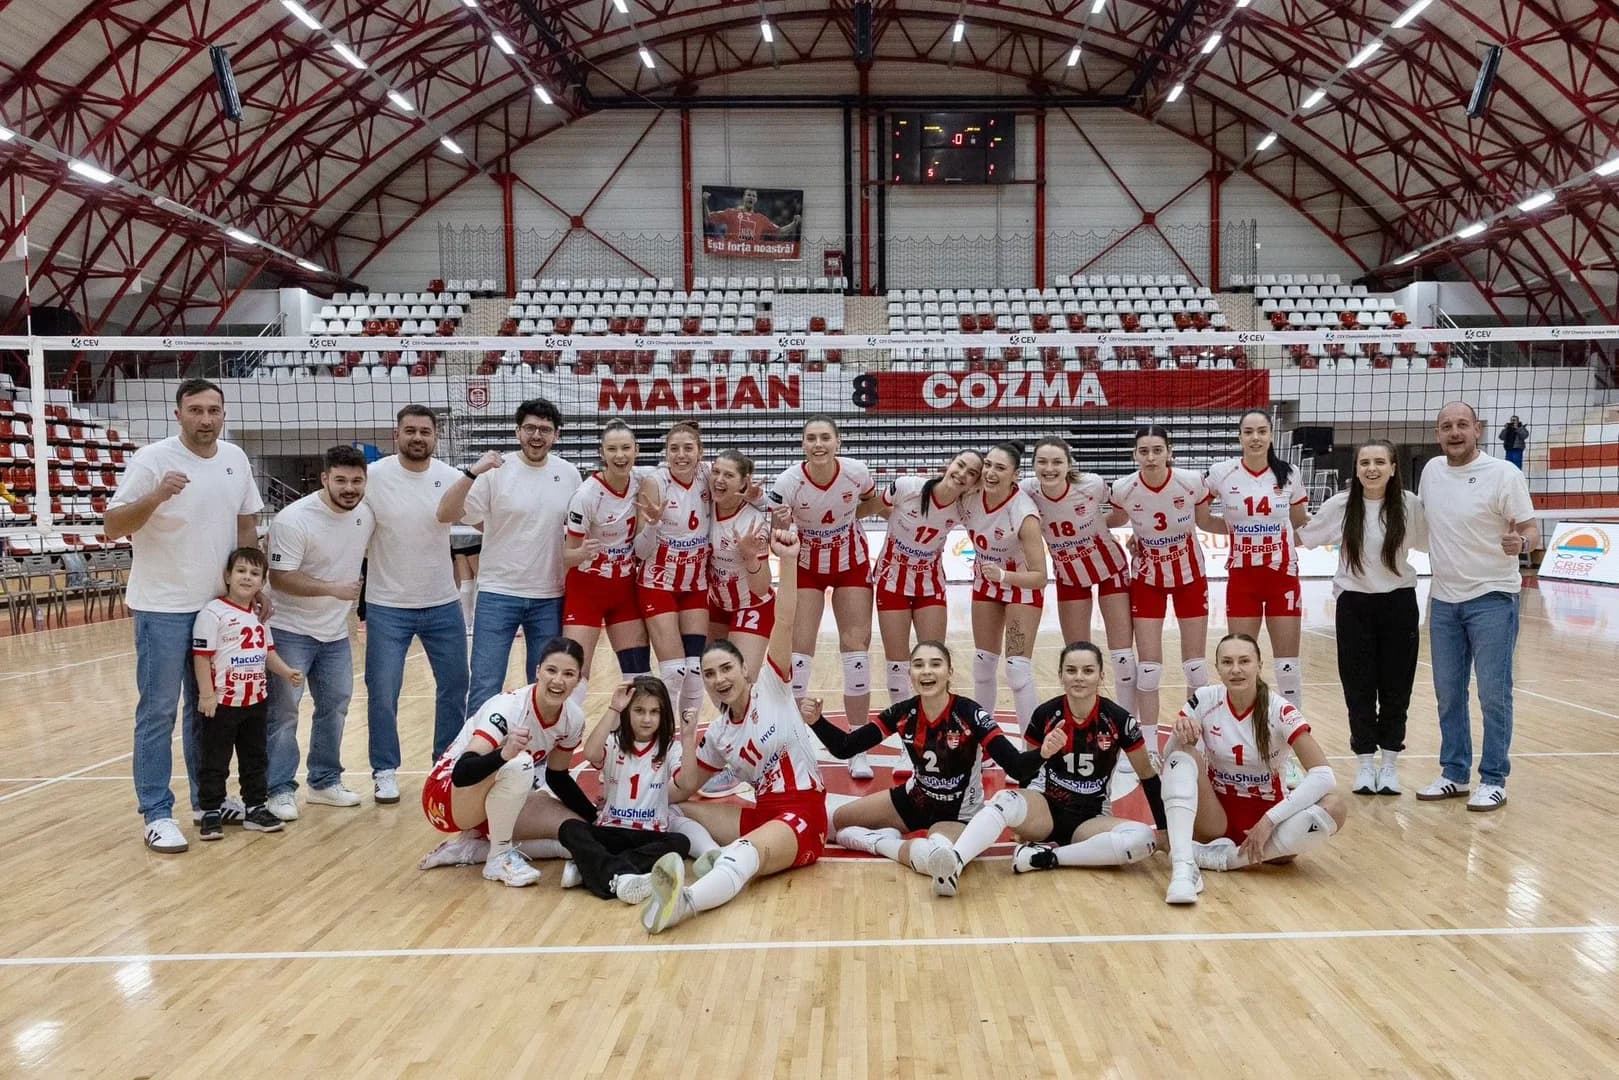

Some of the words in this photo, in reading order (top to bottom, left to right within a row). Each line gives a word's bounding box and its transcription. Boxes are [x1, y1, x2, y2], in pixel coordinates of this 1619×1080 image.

[83, 339, 99, 347] CEV
[321, 339, 337, 347] CEV
[556, 339, 573, 347] CEV
[790, 338, 806, 346] CEV
[1021, 336, 1037, 344] CEV
[1250, 334, 1265, 342] CEV
[1475, 330, 1492, 338] CEV
[598, 375, 800, 411] MARIAN
[852, 374, 878, 409] 8
[922, 372, 1109, 408] COZMA
[1243, 496, 1272, 516] 14
[688, 510, 699, 531] 6
[821, 510, 835, 524] 4
[1153, 512, 1168, 531] 3
[914, 526, 939, 545] 17
[1048, 521, 1076, 538] 18
[1554, 560, 1593, 570] CRISS
[736, 609, 760, 630] 12
[240, 625, 265, 649] 23
[739, 738, 763, 767] 11
[922, 750, 940, 773] 2
[1232, 744, 1244, 766] 1
[1062, 752, 1095, 777] 15
[630, 774, 640, 800] 1
